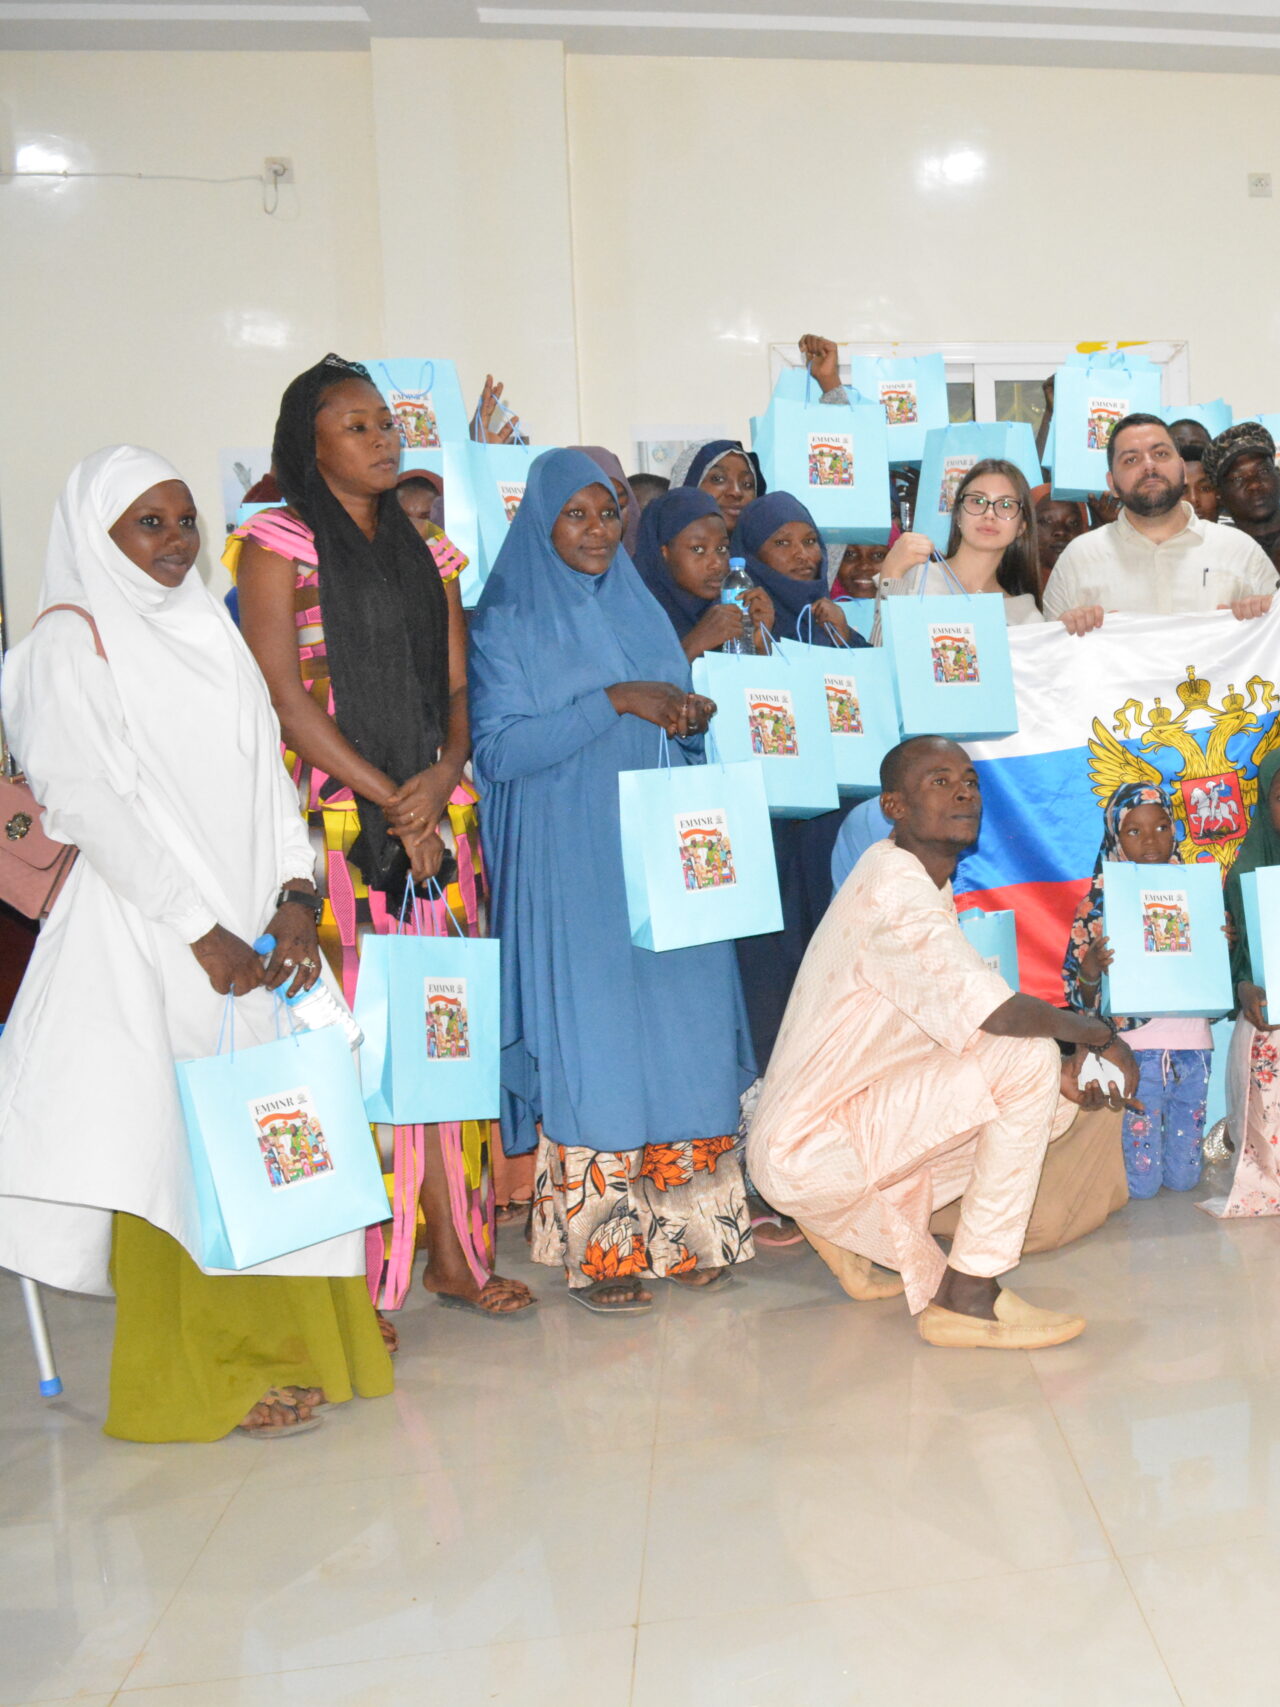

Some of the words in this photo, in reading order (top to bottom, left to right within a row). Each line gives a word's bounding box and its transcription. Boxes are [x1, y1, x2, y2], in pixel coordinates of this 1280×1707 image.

[1091, 401, 1117, 409] EMMNR
[750, 693, 779, 703] EMMNR
[680, 814, 713, 829] EMMNR
[1144, 894, 1174, 902] EMMNR
[428, 983, 455, 993] EMMNR
[255, 1097, 294, 1115] EMMNR
